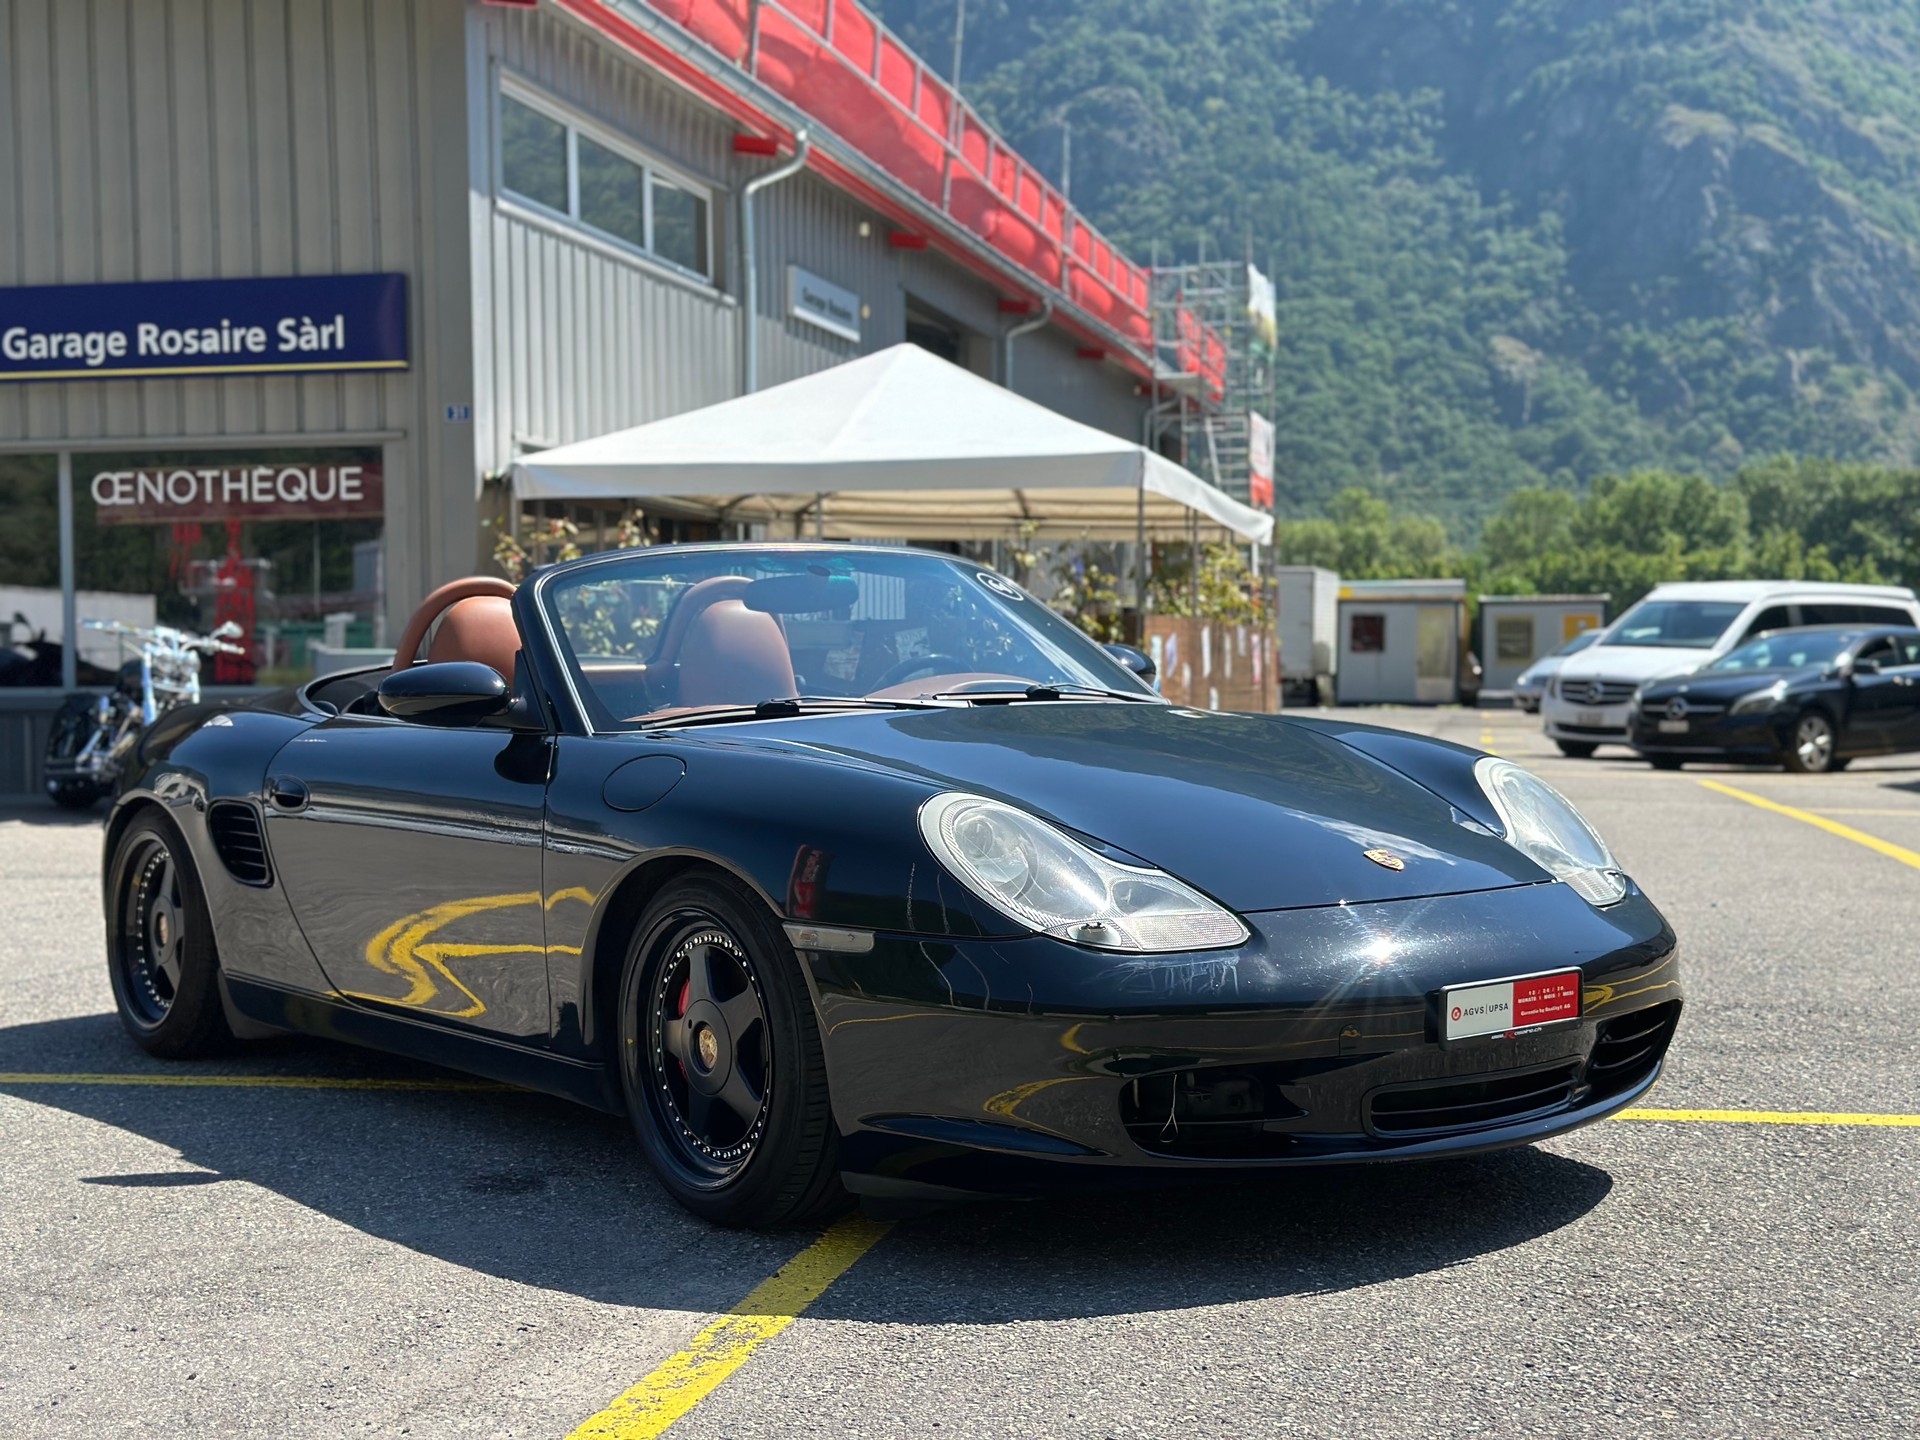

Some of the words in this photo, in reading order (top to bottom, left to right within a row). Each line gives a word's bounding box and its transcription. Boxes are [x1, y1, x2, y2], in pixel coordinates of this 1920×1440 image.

[2, 326, 127, 366] Garage
[137, 319, 267, 356] Rosaire
[277, 315, 345, 352] Sàrl
[91, 466, 363, 505] ŒNOTHÈQUE
